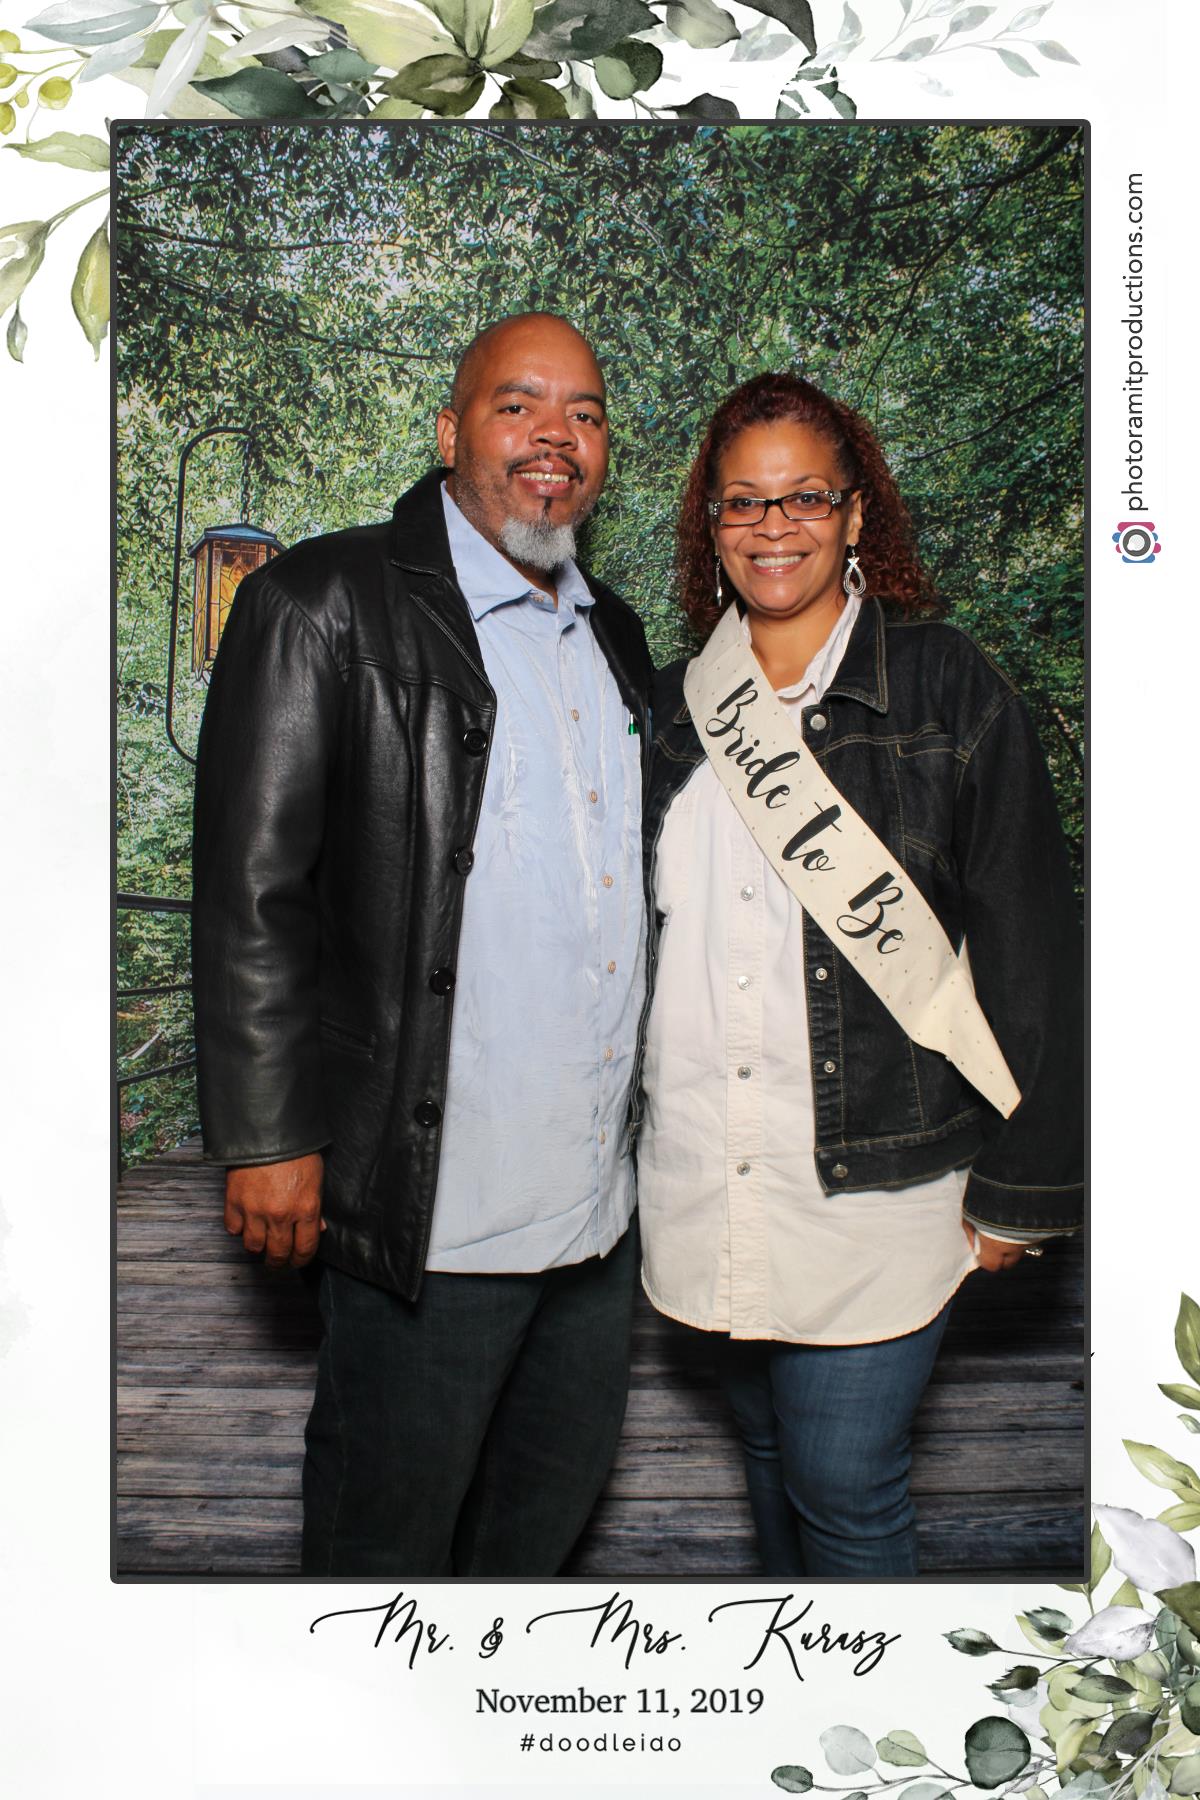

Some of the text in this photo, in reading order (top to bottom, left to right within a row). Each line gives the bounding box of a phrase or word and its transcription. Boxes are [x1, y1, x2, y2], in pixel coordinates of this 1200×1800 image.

[705, 678, 904, 954] Bride to Be
